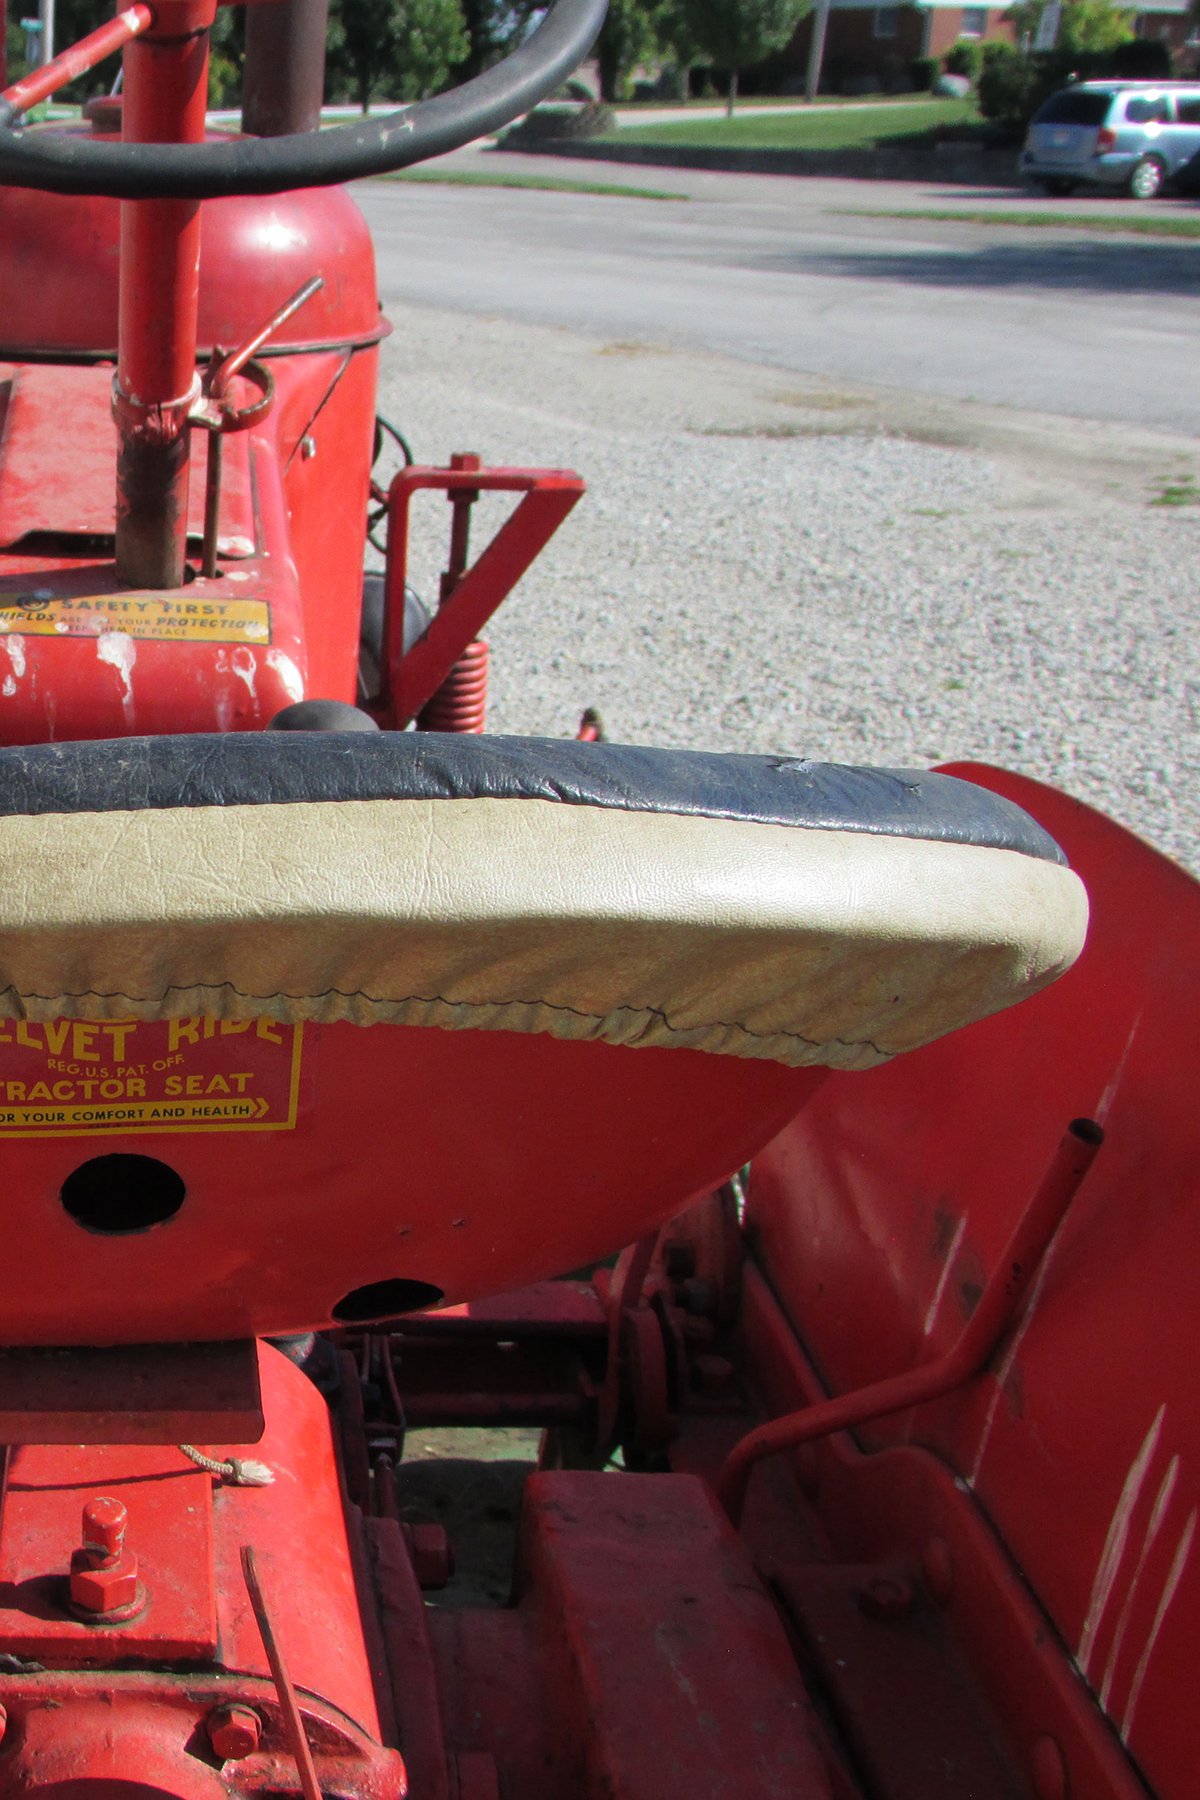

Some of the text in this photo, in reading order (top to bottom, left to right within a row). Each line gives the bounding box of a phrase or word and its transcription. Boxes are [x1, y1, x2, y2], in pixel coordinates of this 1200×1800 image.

[61, 598, 228, 615] SAFETY FIRST
[168, 1014, 283, 1052] RIDE
[116, 1064, 149, 1077] PAT.
[152, 1054, 185, 1071] OFF.
[164, 1072, 254, 1096] SEAT
[23, 1111, 66, 1122] YOUR
[72, 1108, 145, 1121] COMFORT
[150, 1107, 186, 1118] AND
[191, 1104, 250, 1117] HEALTH
